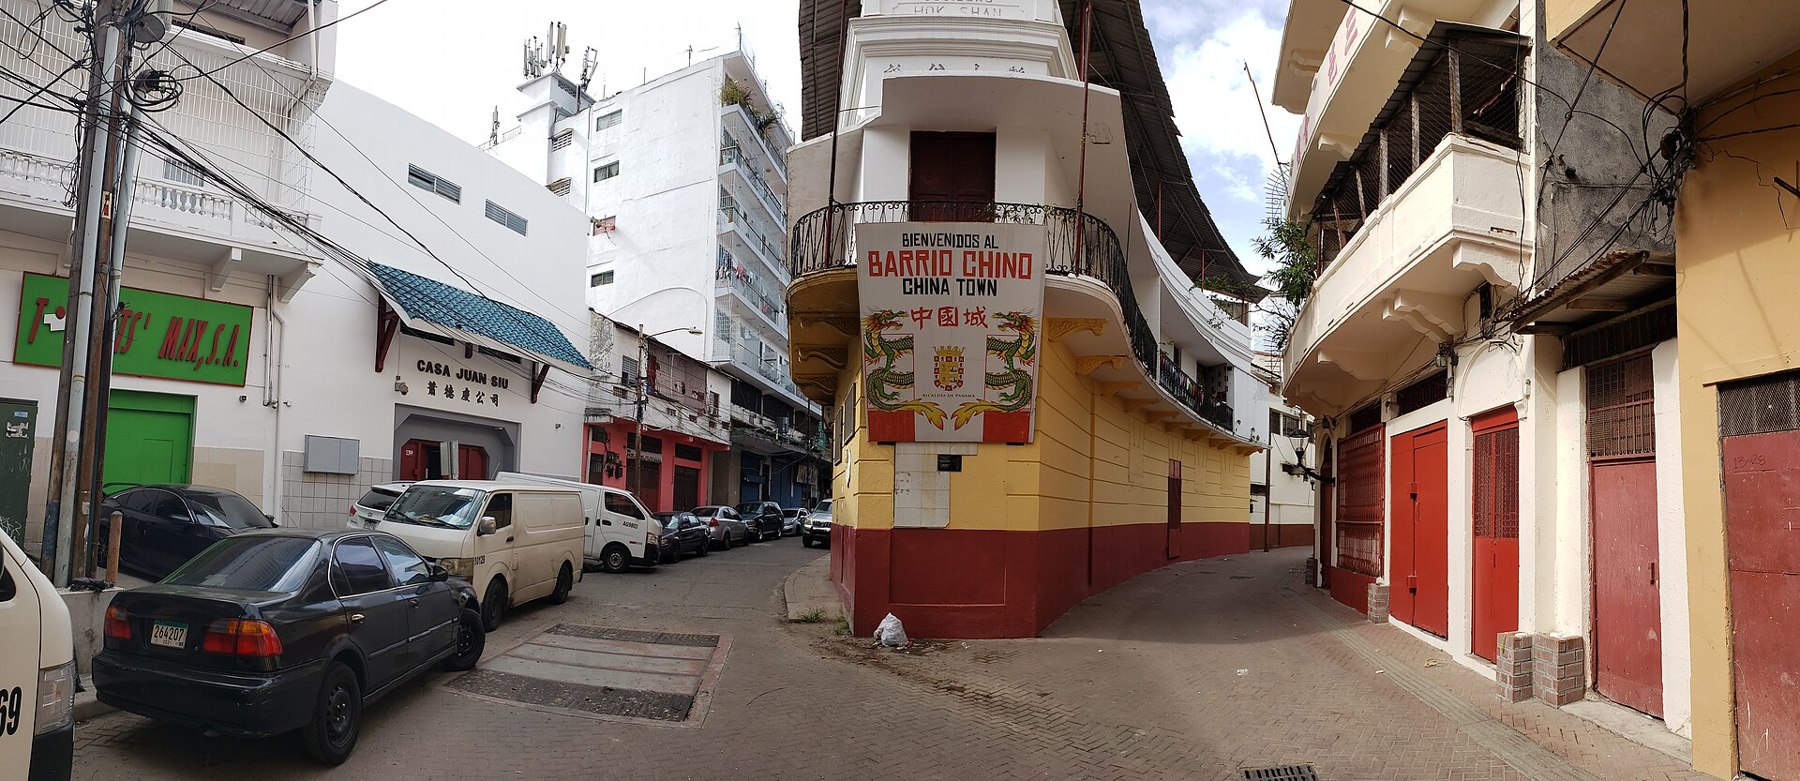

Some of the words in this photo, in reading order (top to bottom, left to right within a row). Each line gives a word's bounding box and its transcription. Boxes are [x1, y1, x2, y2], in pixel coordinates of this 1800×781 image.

[902, 233, 980, 249] BIENVENIDOS
[984, 235, 999, 249] AL
[868, 250, 953, 278] BARRIO
[963, 250, 1032, 280] CHINO
[902, 278, 950, 296] CHINA
[956, 278, 998, 297] TOWN
[911, 306, 988, 331] 中國城
[416, 359, 451, 377] CASA
[456, 368, 487, 385] JUAN
[490, 375, 509, 390] SIU
[154, 625, 185, 641] 264207
